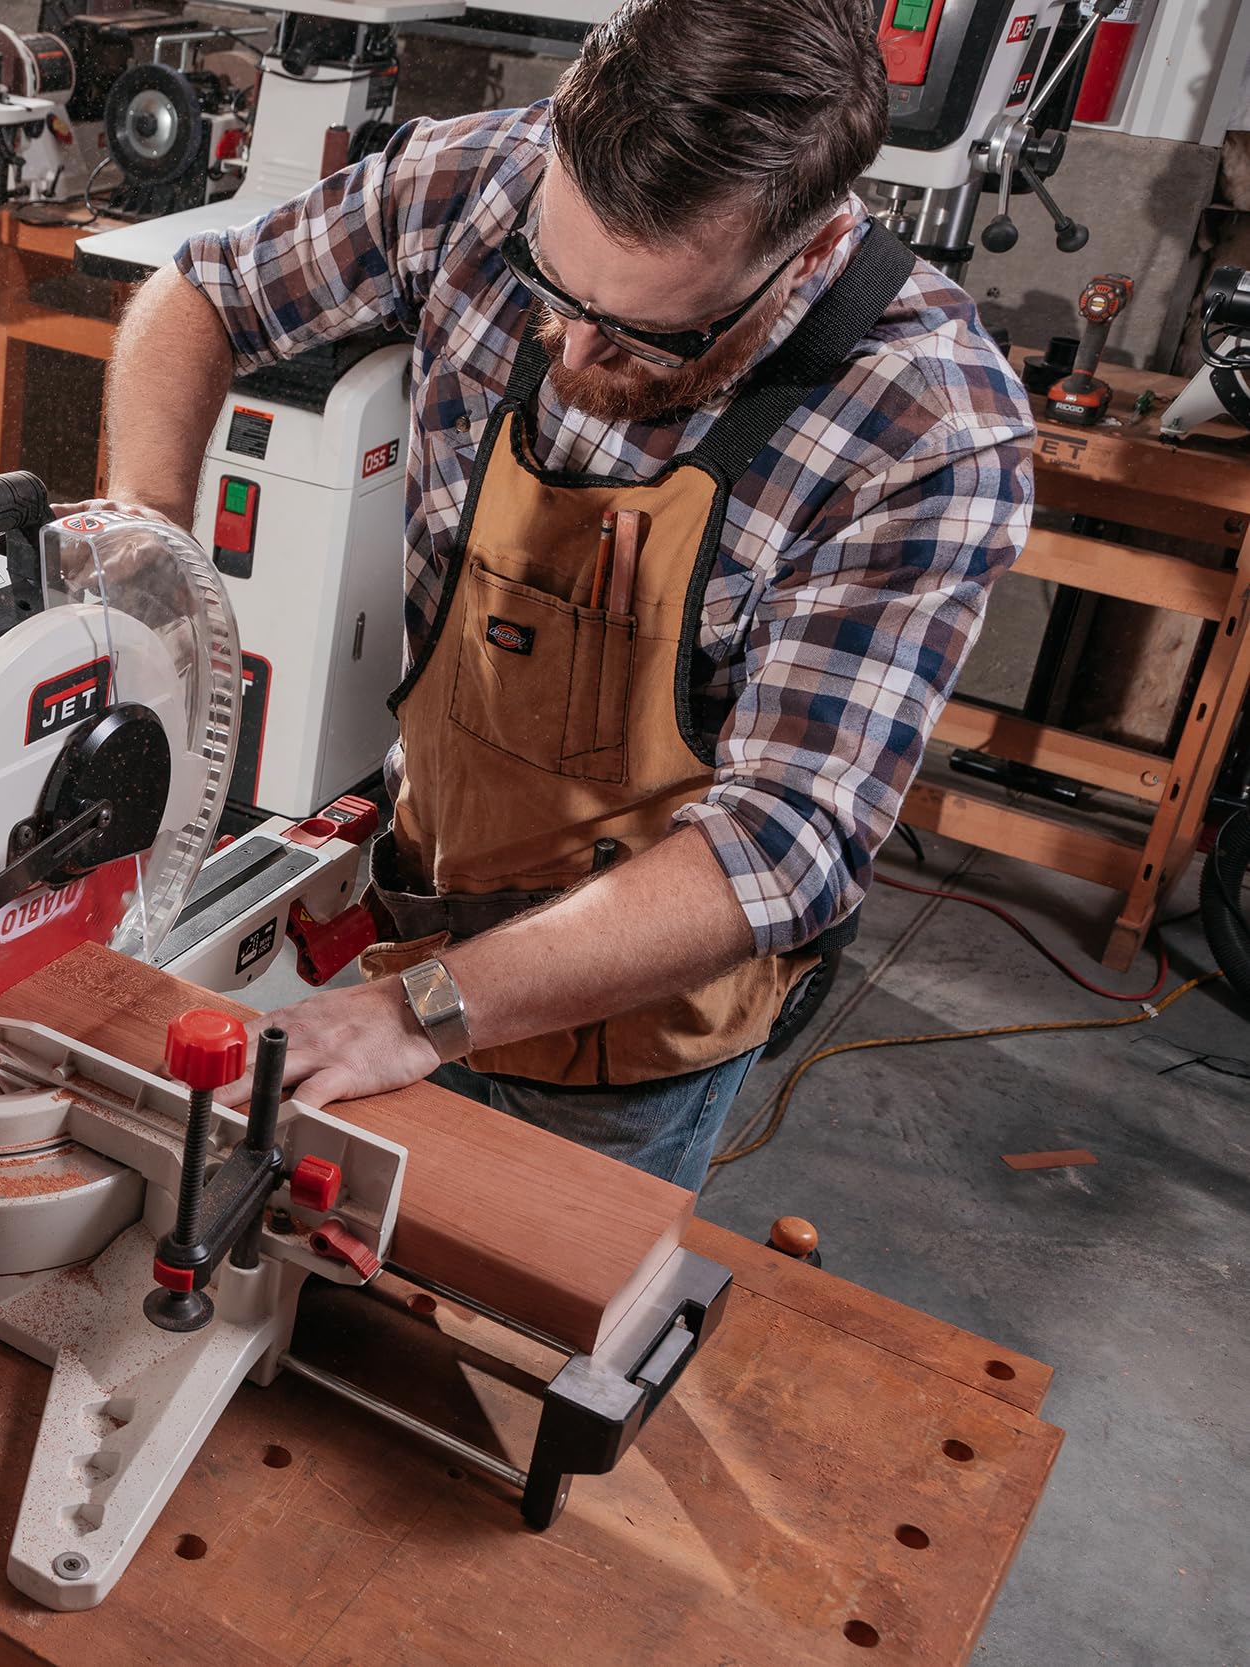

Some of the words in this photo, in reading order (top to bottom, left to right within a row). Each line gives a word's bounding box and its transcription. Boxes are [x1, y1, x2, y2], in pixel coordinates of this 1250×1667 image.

[1012, 80, 1030, 95] JET
[389, 444, 398, 463] 5
[1041, 440, 1087, 460] ET
[42, 687, 97, 728] JET
[0, 881, 80, 937] DIABLO
